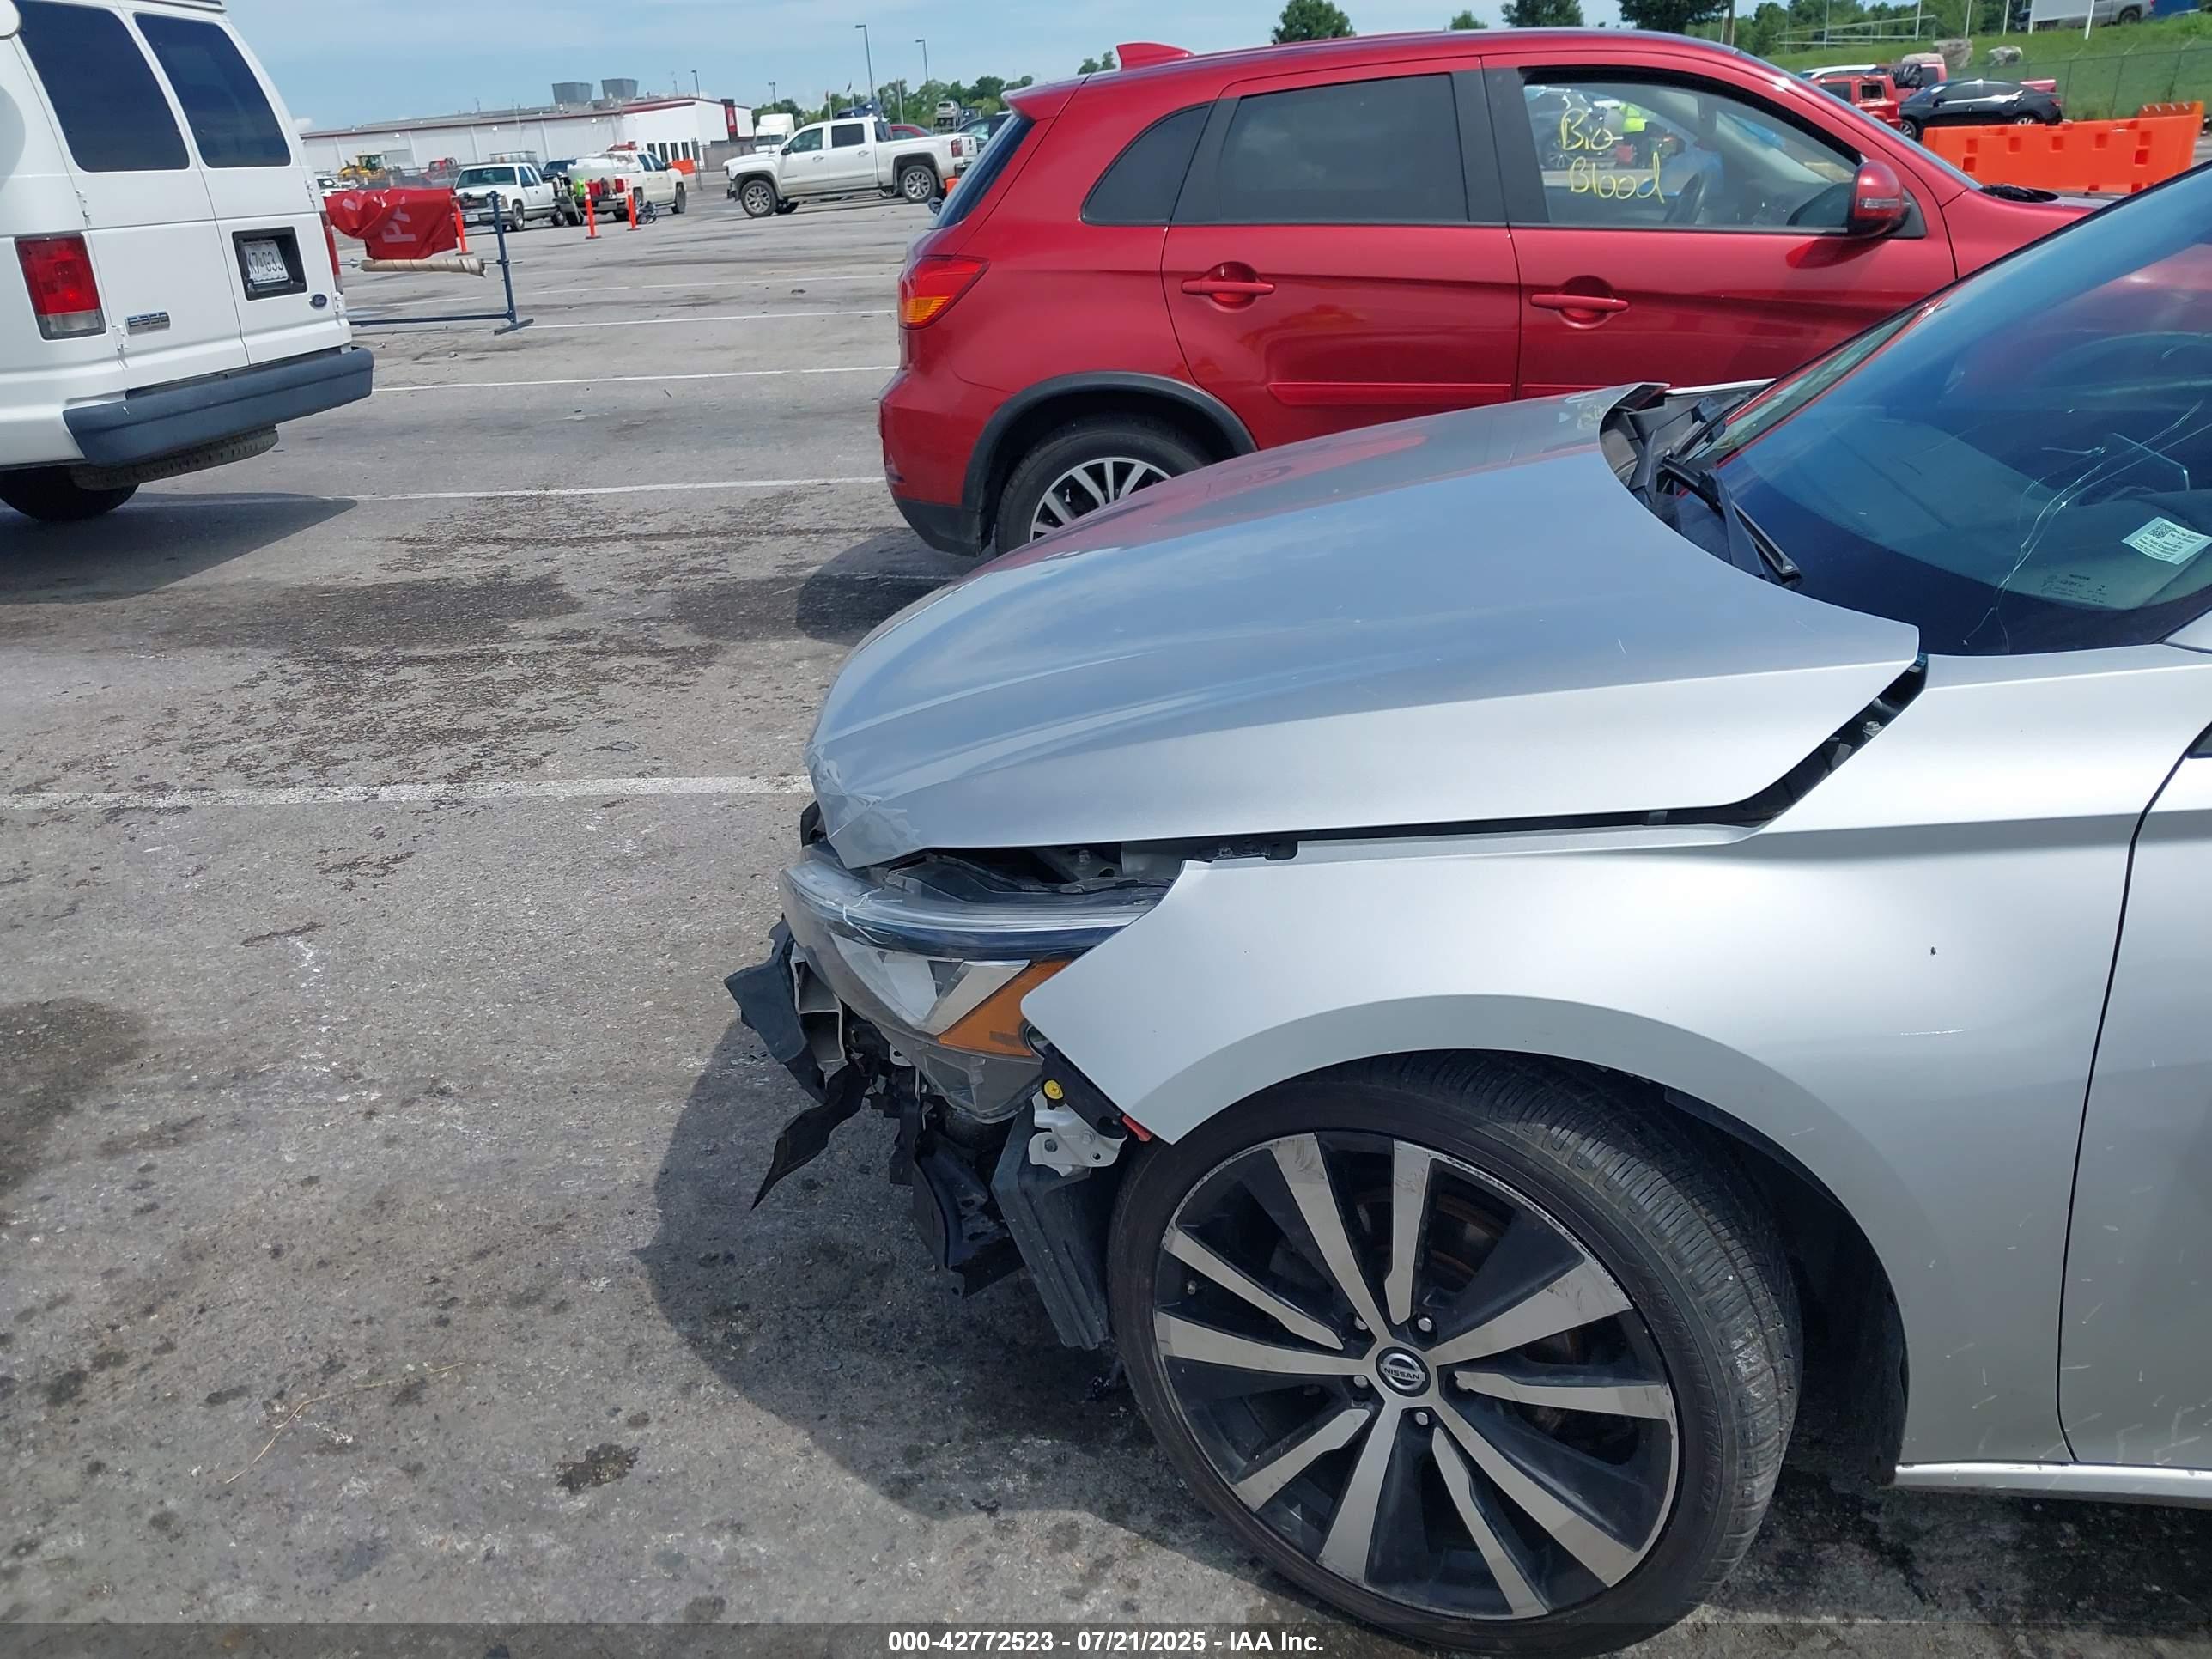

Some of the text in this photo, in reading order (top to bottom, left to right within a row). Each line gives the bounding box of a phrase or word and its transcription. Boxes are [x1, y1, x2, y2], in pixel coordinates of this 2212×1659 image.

[1559, 108, 1615, 152] Bio
[1568, 151, 1665, 204] Blood
[127, 312, 169, 327] E350
[1383, 1367, 1420, 1380] NISSAN
